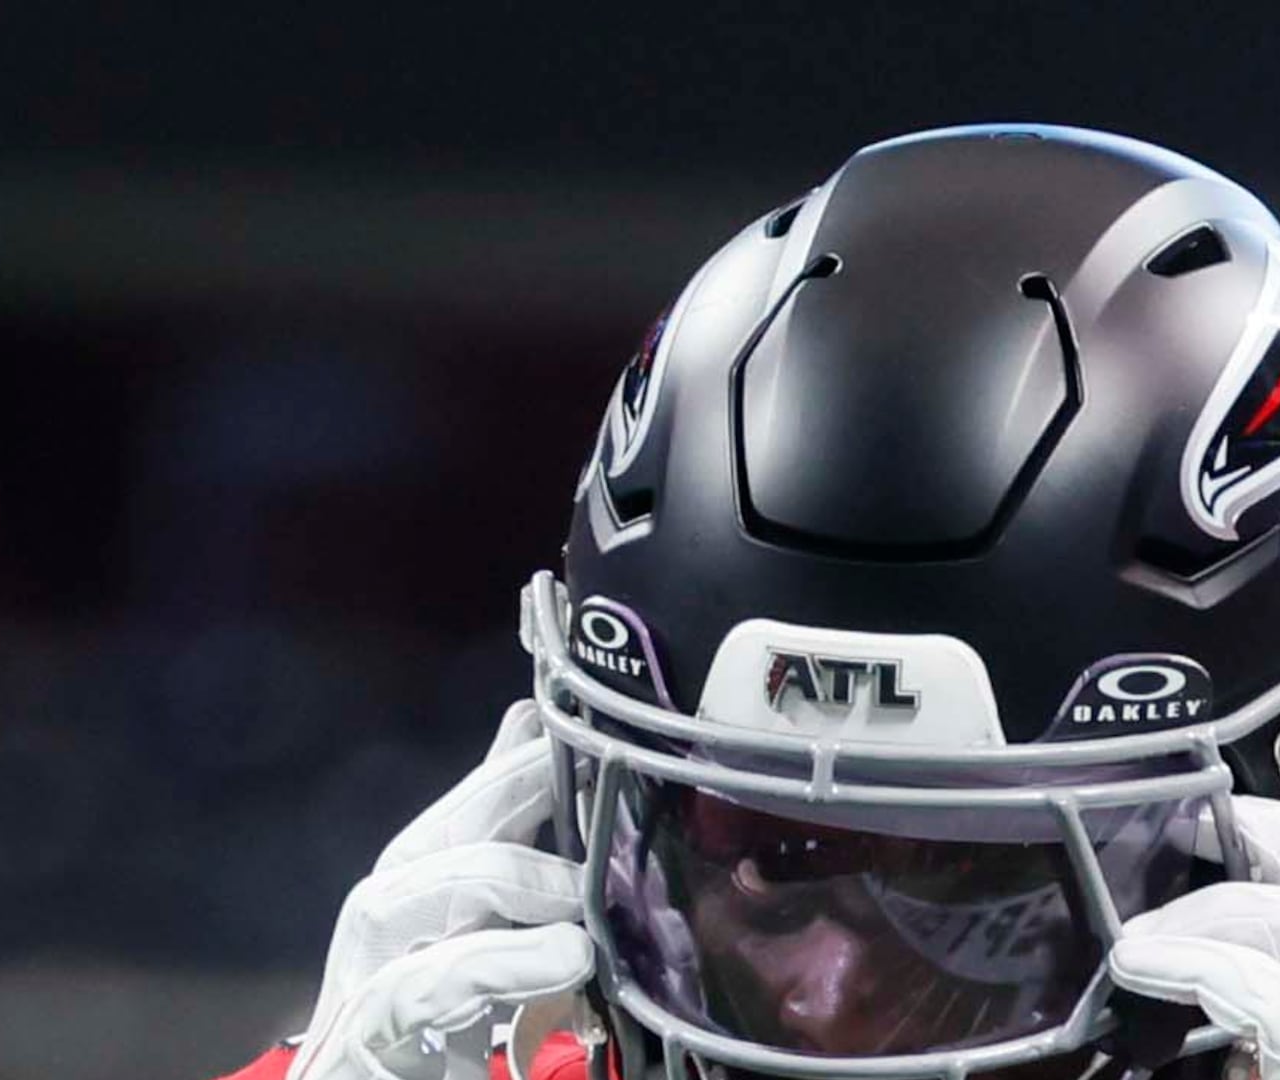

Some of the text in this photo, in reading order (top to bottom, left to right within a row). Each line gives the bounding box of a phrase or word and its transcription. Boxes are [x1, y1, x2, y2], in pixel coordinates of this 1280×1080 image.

[572, 637, 642, 677] OAKLEY
[764, 647, 922, 712] ATL
[1072, 700, 1201, 722] OAKLEY
